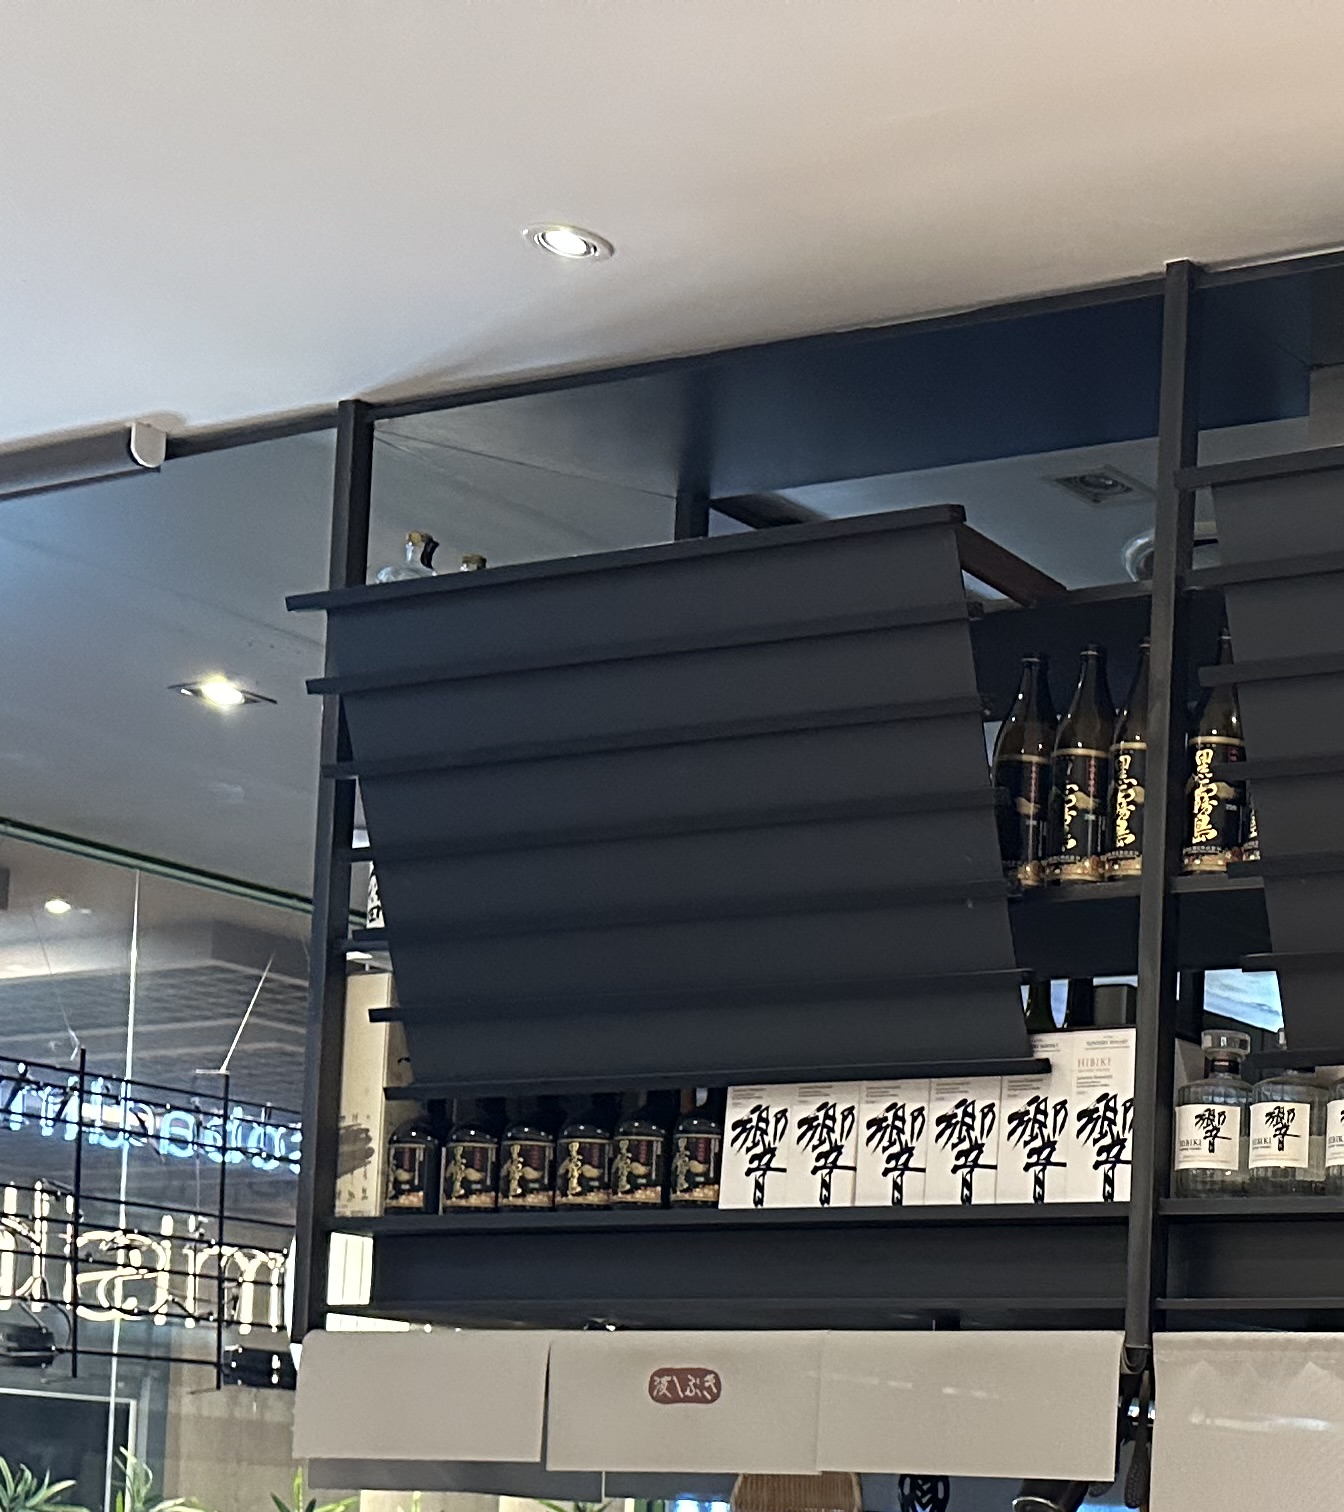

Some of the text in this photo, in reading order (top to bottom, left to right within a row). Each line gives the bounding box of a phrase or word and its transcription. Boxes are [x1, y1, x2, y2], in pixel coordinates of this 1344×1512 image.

[1077, 1057, 1111, 1068] HIBIKI
[731, 1103, 788, 1207] 響
[797, 1100, 857, 1206] 響
[866, 1100, 927, 1206] 響
[935, 1098, 999, 1206] 響
[1007, 1095, 1068, 1204] 響
[1076, 1092, 1135, 1203] 響
[1195, 1108, 1231, 1153] 響
